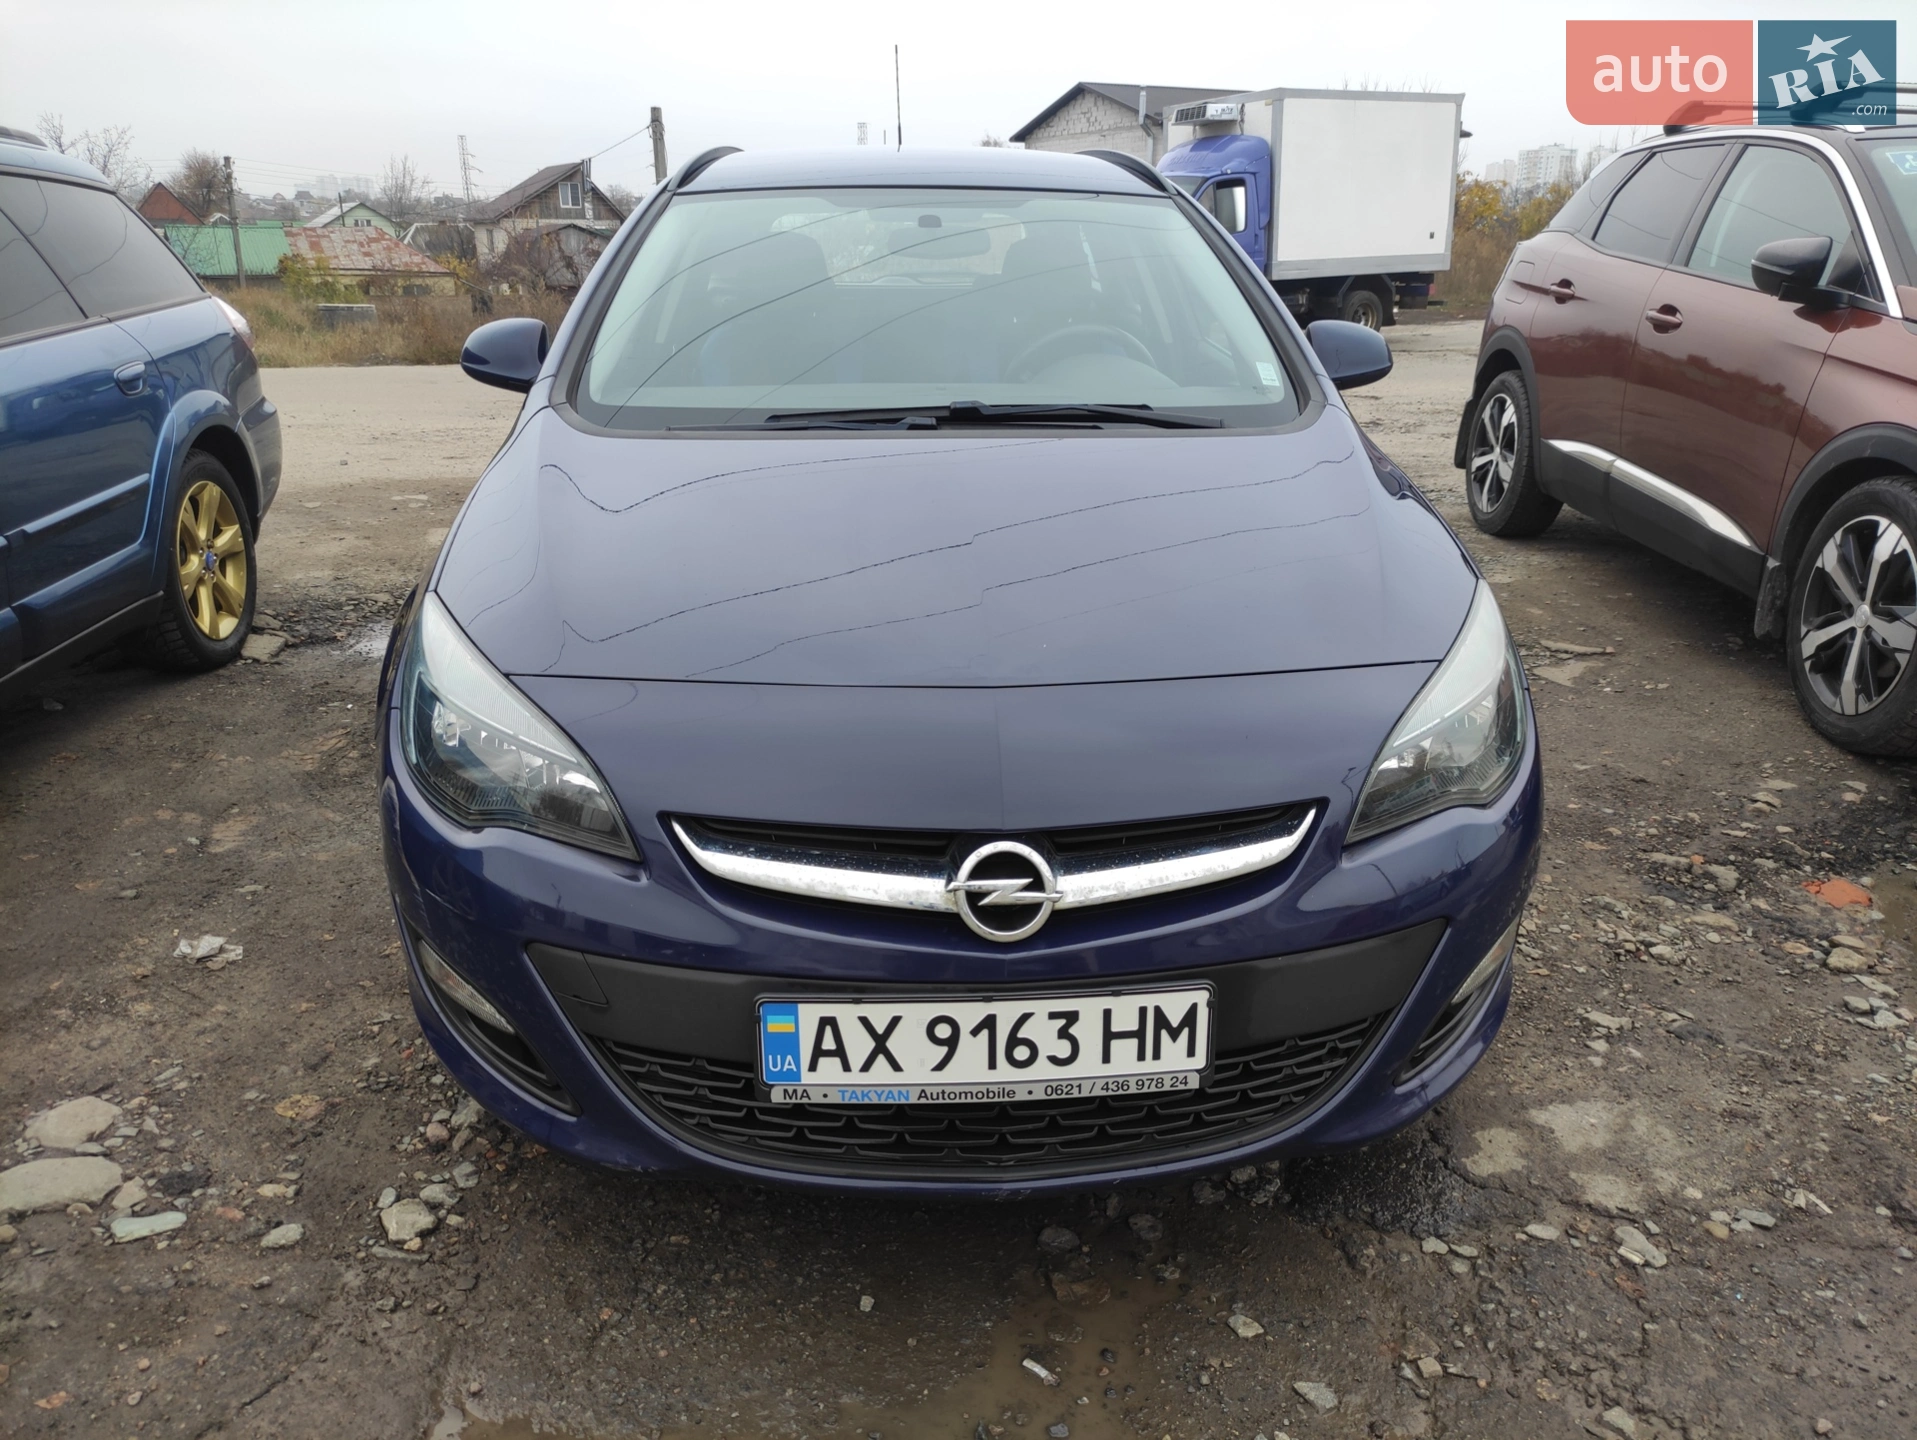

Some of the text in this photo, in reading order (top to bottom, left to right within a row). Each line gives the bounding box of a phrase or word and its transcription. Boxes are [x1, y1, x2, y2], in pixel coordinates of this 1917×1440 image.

[807, 1002, 1198, 1072] AX 9163 HM
[768, 1055, 797, 1072] UA
[782, 1088, 812, 1102] MA
[838, 1089, 910, 1103] TAKYAN
[917, 1086, 1017, 1101] Automobile
[1044, 1083, 1082, 1097] 0621
[1100, 1079, 1130, 1093] 436
[1135, 1077, 1165, 1091] 978
[1169, 1075, 1189, 1088] 24
